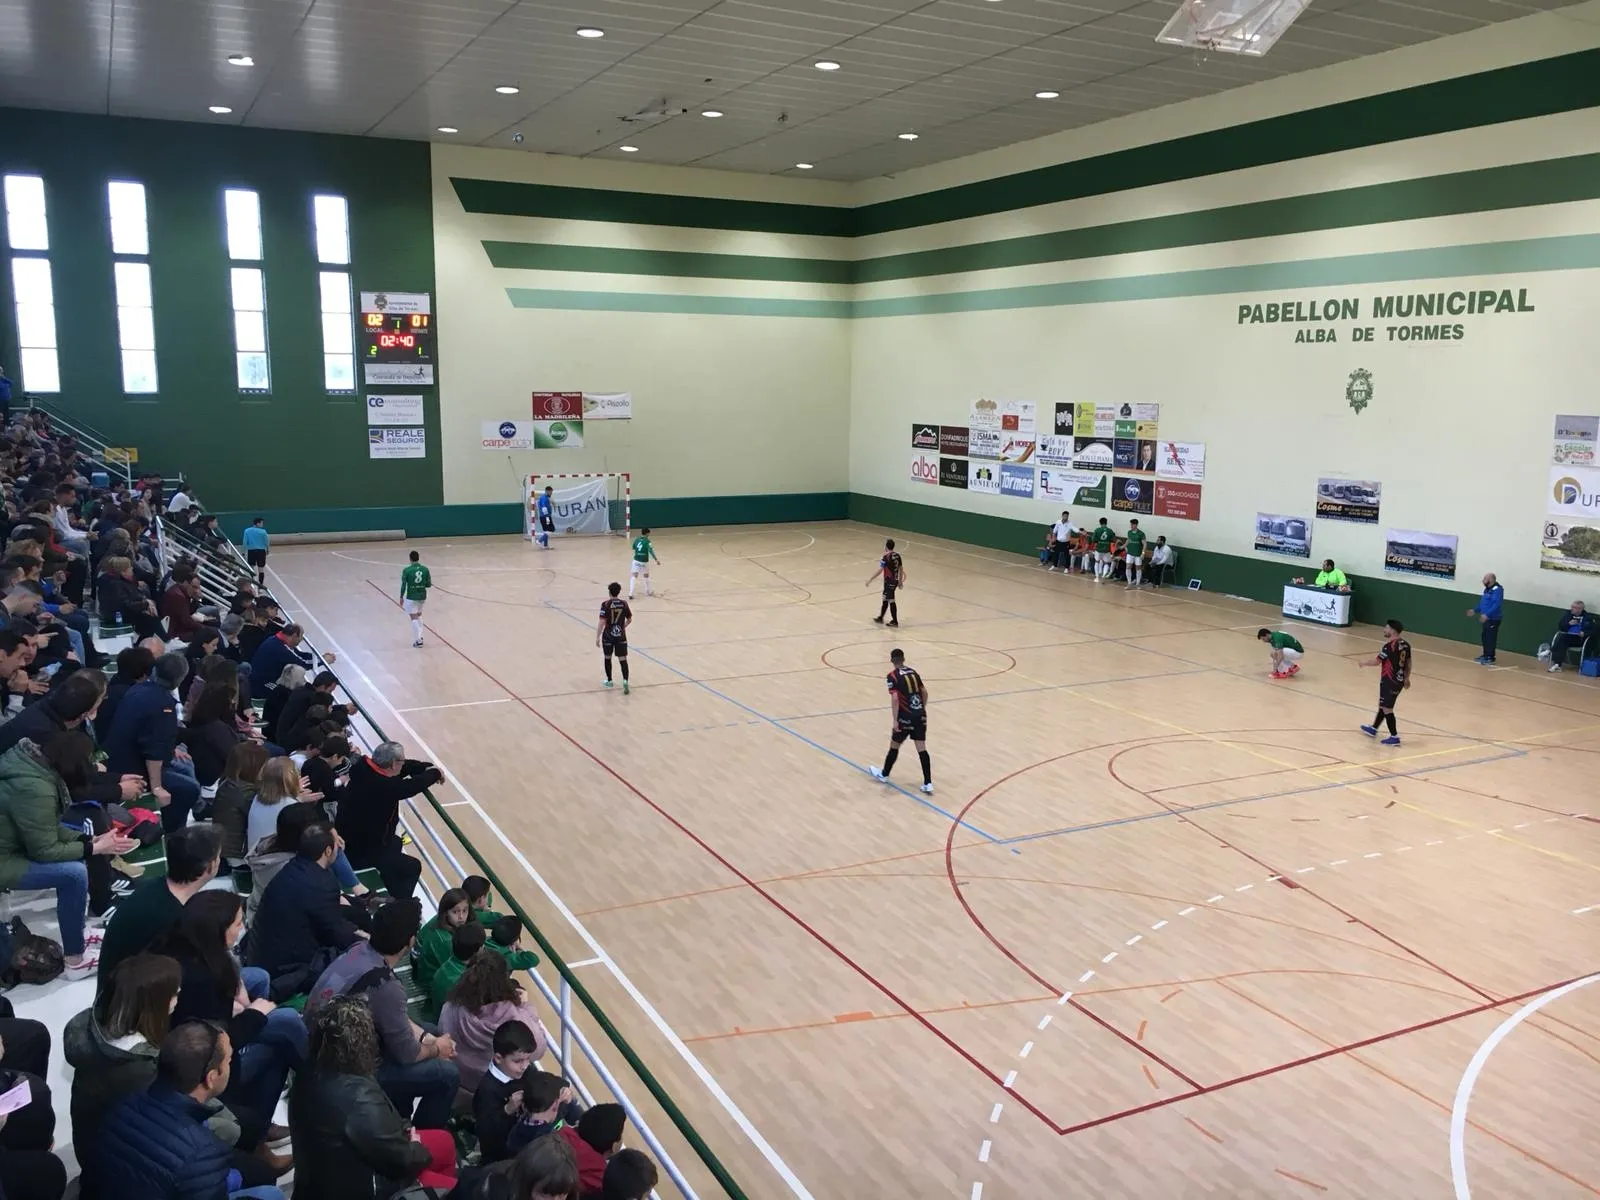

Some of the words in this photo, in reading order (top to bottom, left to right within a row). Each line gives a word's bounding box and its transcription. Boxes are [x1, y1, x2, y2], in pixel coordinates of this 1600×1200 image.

[1238, 298, 1359, 324] PABELLON
[1373, 288, 1536, 318] MUNICIPAL
[367, 313, 384, 326] 02
[412, 315, 428, 327] 01
[1295, 328, 1337, 343] ALBA
[1352, 327, 1374, 342] DE
[1386, 324, 1464, 342] TORMES
[381, 335, 414, 347] 02:40
[558, 496, 606, 517] URÁN
[1317, 502, 1343, 511] Cosme
[1387, 554, 1414, 565] Cosme
[414, 571, 422, 583] 8
[611, 608, 622, 624] 17
[904, 674, 919, 693] 11
